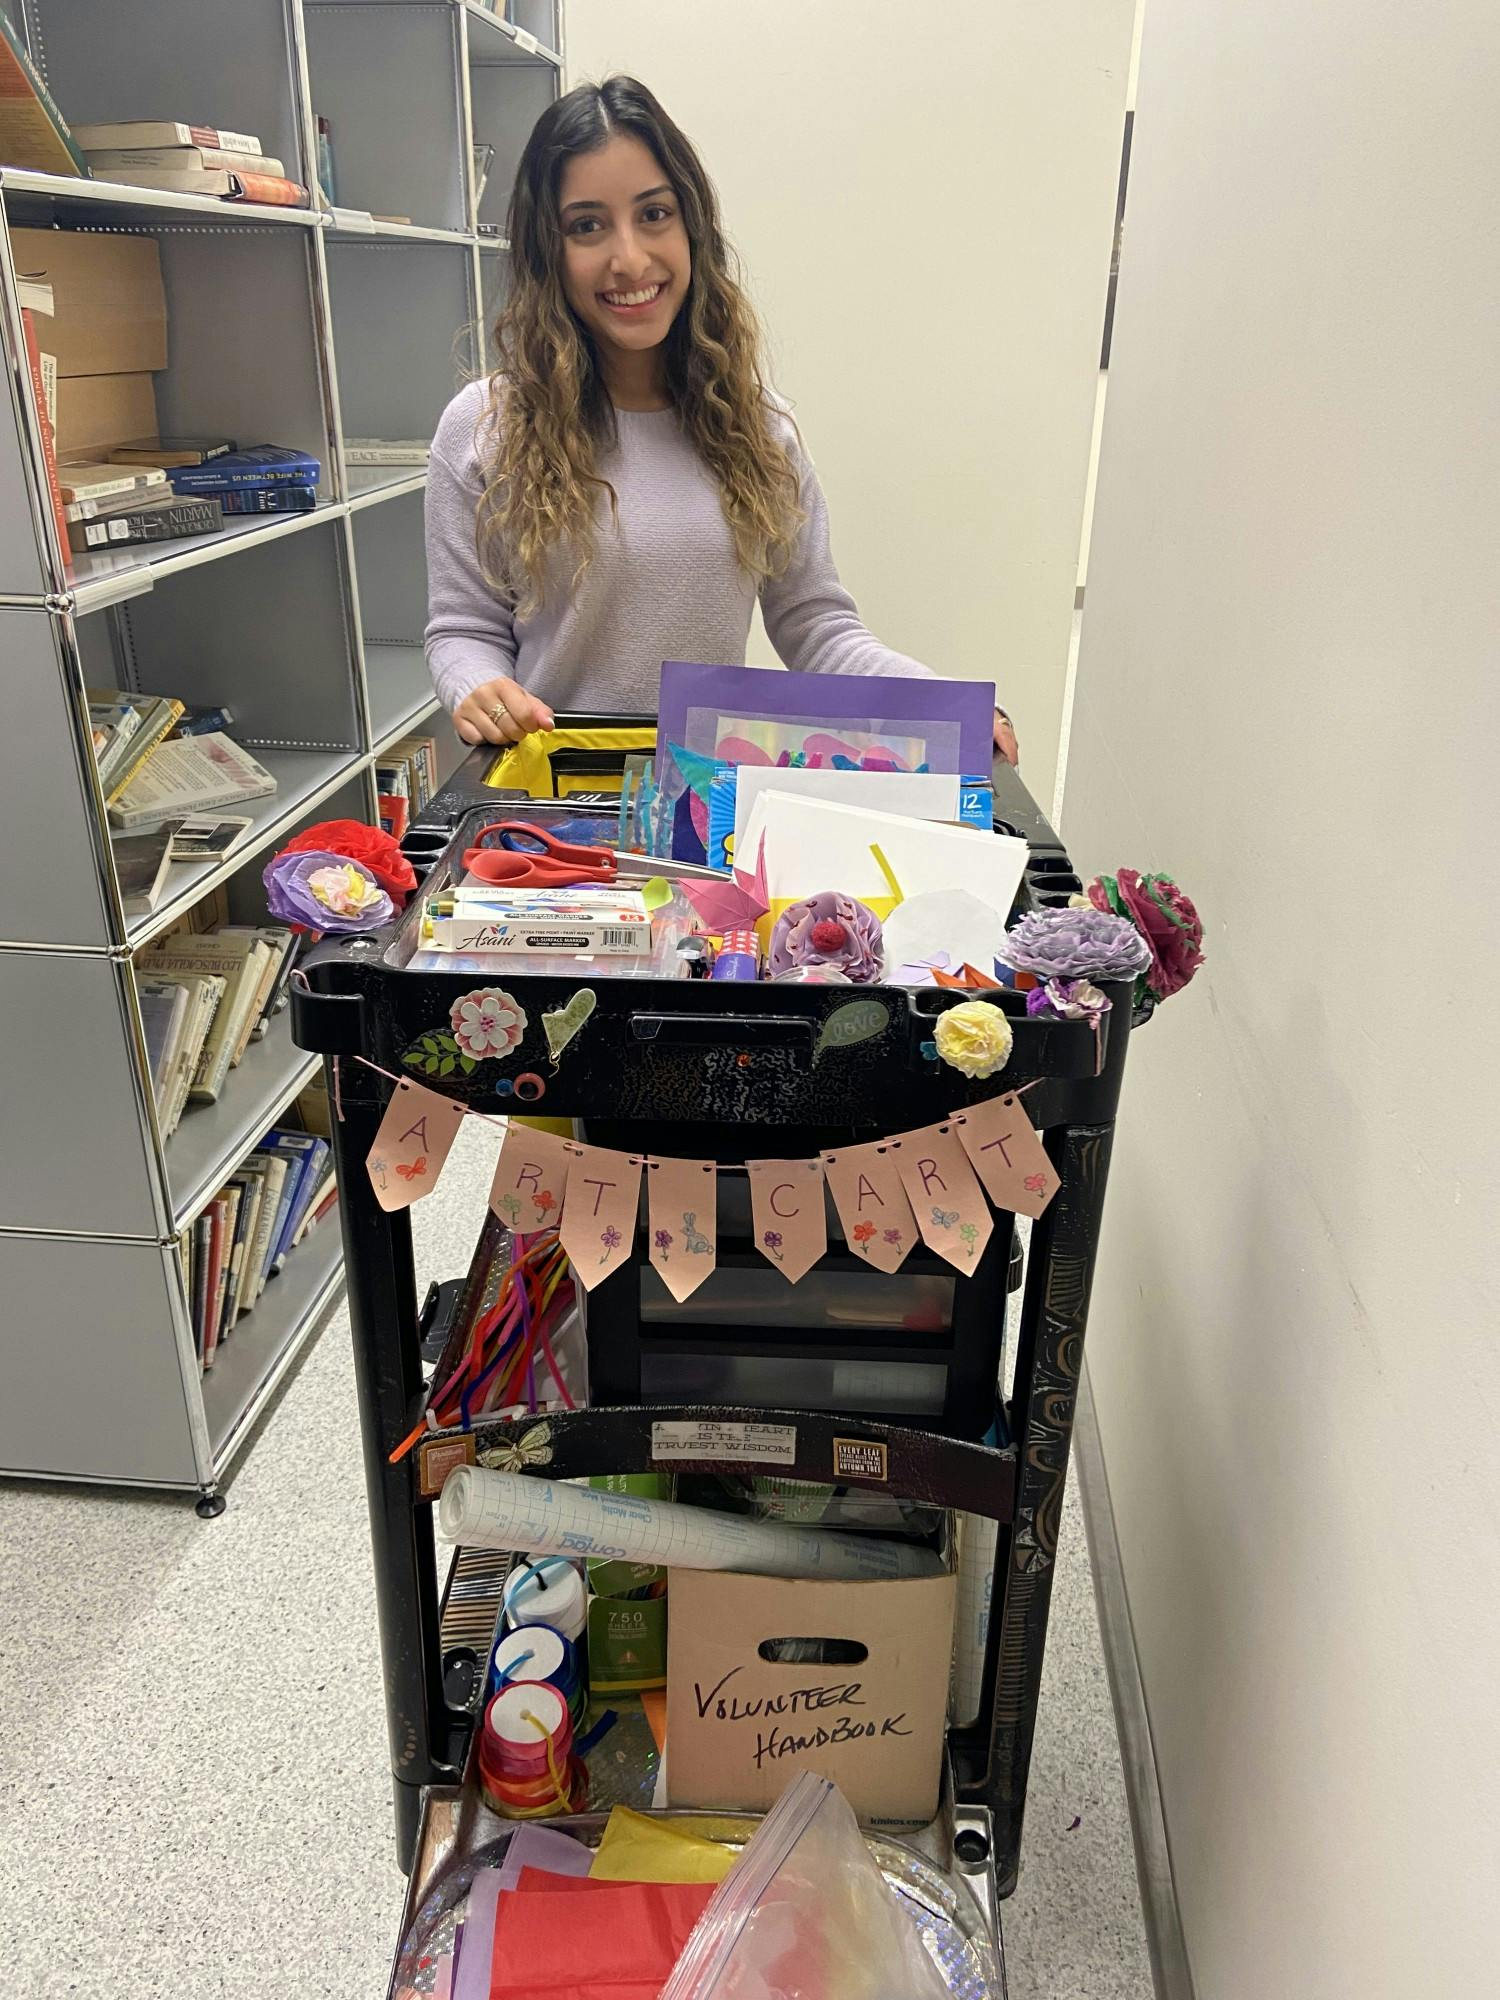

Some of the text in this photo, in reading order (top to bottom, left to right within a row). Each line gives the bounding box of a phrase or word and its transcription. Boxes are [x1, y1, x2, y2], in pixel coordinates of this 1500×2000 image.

[169, 504, 213, 524] MARTIN
[963, 793, 982, 809] 12
[456, 927, 518, 950] Asani
[696, 1432, 712, 1440] IS
[653, 1441, 793, 1454] TRUEST WISDOM
[839, 1445, 880, 1457] EVERY LEAF
[839, 1463, 882, 1473] AUTUMN TREE
[600, 1503, 653, 1523] Clear Matte
[608, 1611, 643, 1623] 750
[694, 1665, 866, 1721] VOLUNTEER
[752, 1712, 913, 1770] HANDBOOK
[870, 1817, 929, 1827] kinkos.com
